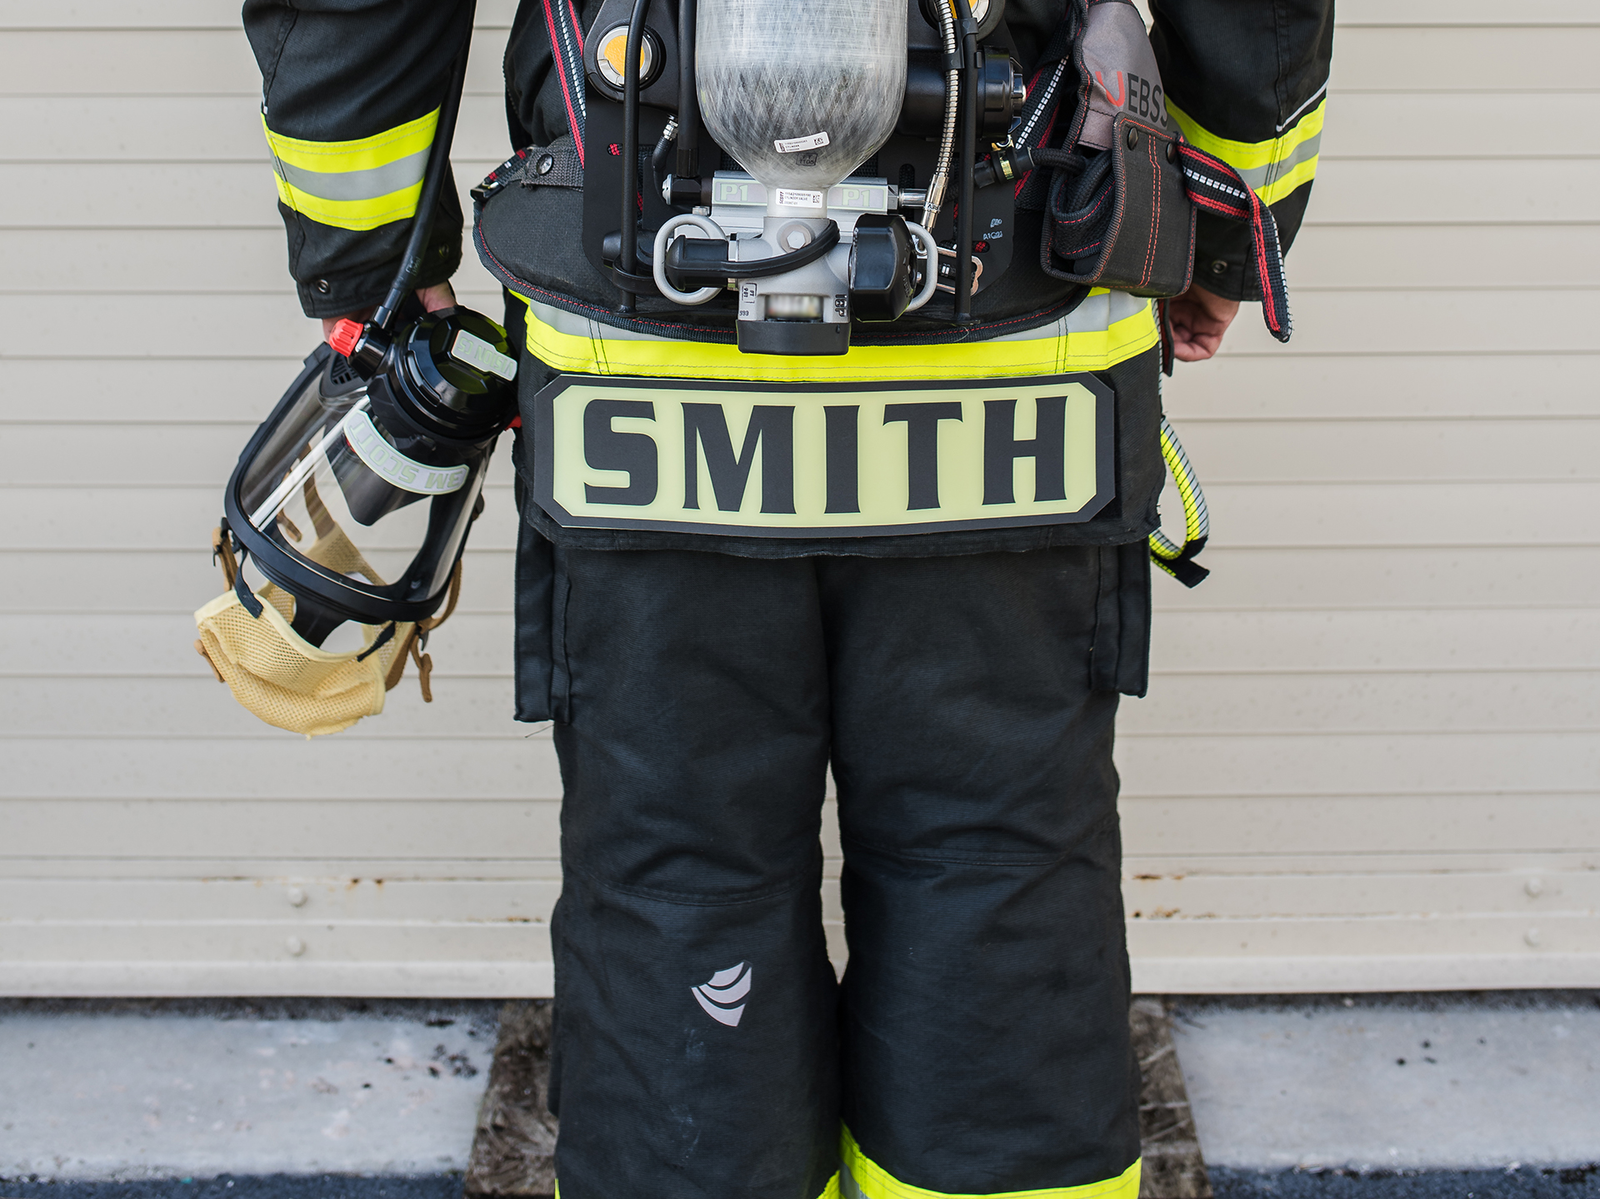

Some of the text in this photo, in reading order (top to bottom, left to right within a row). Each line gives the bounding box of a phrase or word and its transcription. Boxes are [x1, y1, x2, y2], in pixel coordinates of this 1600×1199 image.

[720, 183, 749, 202] P1
[842, 188, 871, 208] P1
[476, 345, 515, 378] VISION
[349, 419, 464, 490] 3M SCOTT
[583, 396, 1069, 515] SMITH
